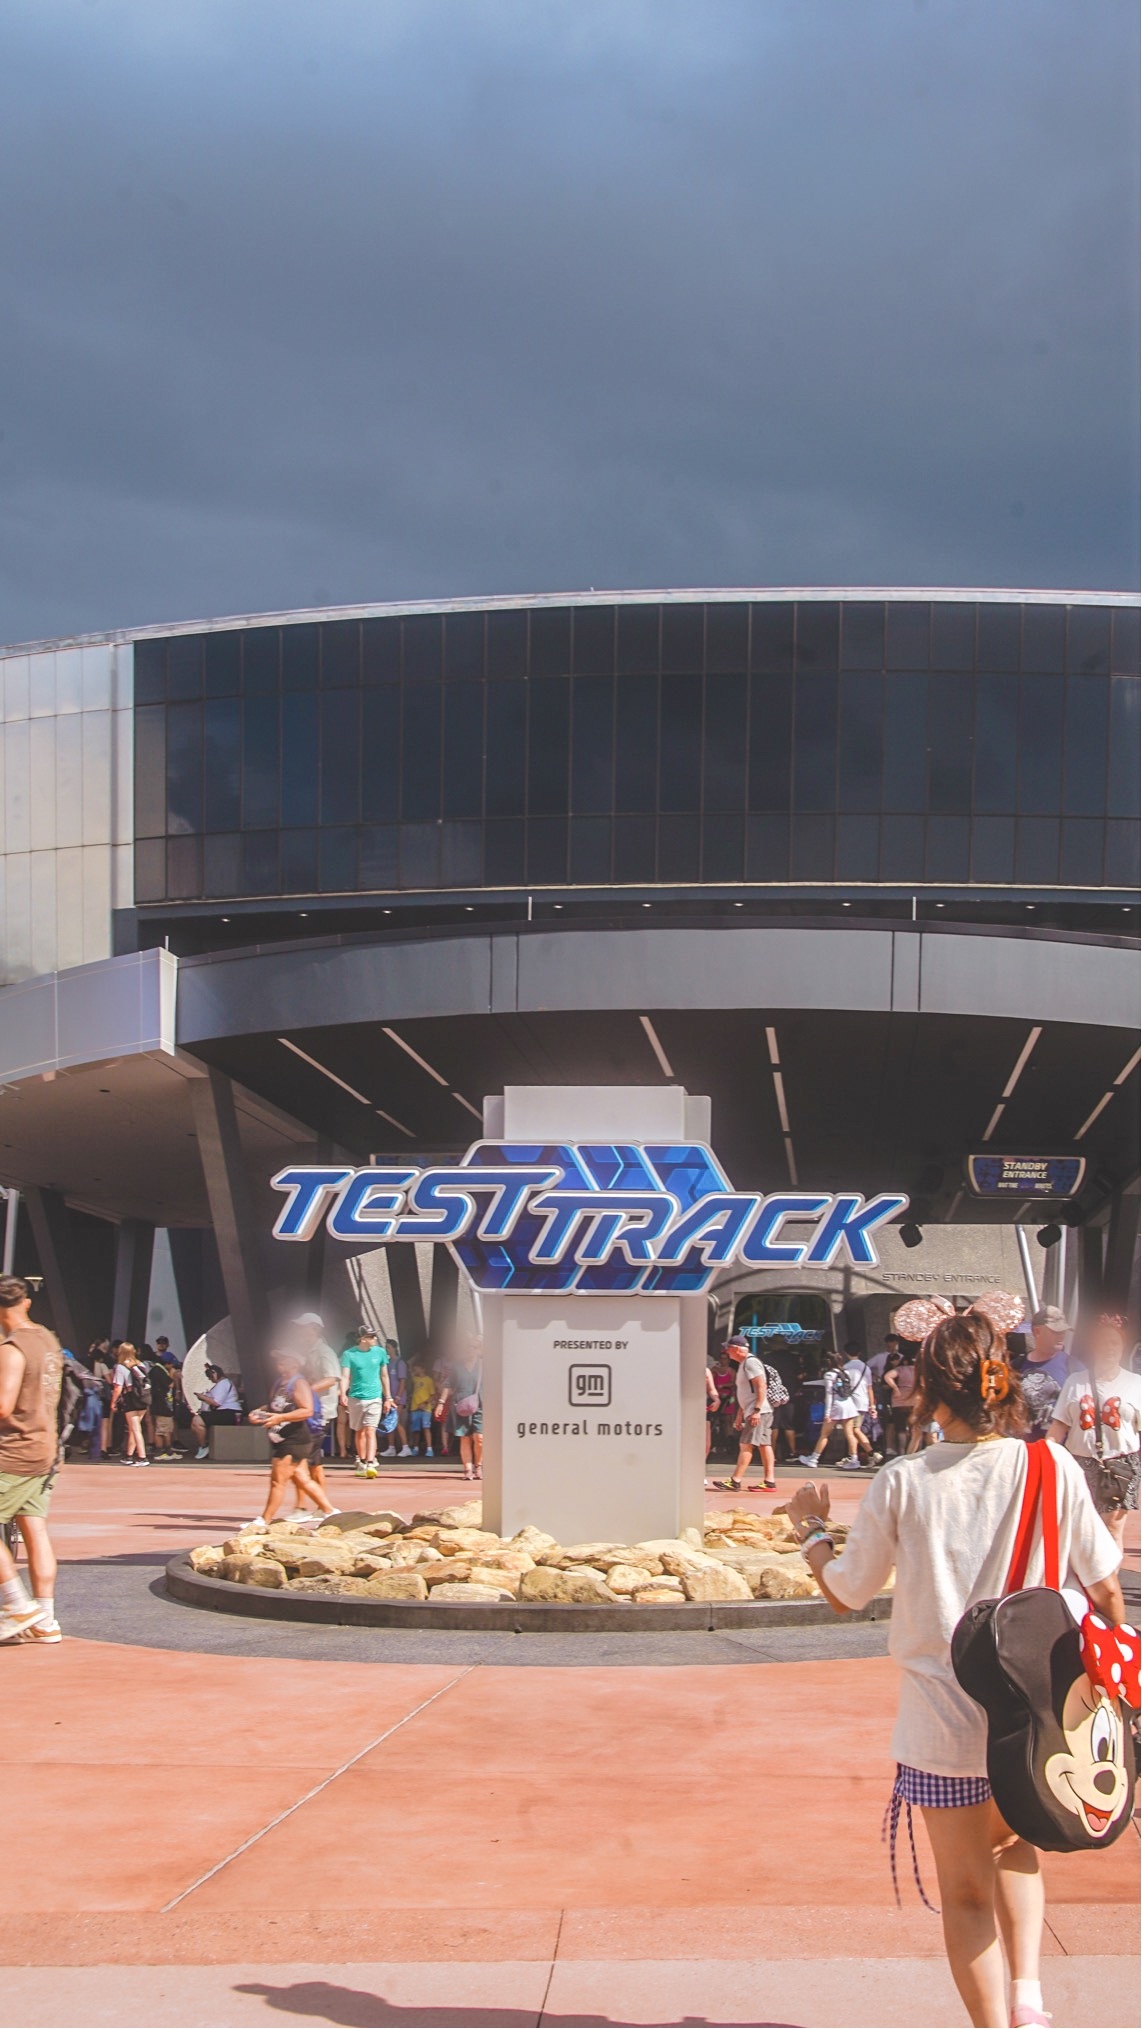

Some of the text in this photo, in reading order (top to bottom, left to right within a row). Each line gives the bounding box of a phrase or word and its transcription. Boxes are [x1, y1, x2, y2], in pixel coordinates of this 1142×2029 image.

[1003, 1162, 1048, 1170] STANDBY
[1002, 1171, 1048, 1179] ENTRANCE
[272, 1166, 564, 1240] TEST
[529, 1192, 908, 1268] TRACK
[882, 1273, 1001, 1284] STANDBY ENTRANCE
[739, 1326, 780, 1337] TEST
[553, 1340, 629, 1350] PRESENTED BY
[576, 1374, 604, 1397] gm
[517, 1419, 663, 1439] general motors
